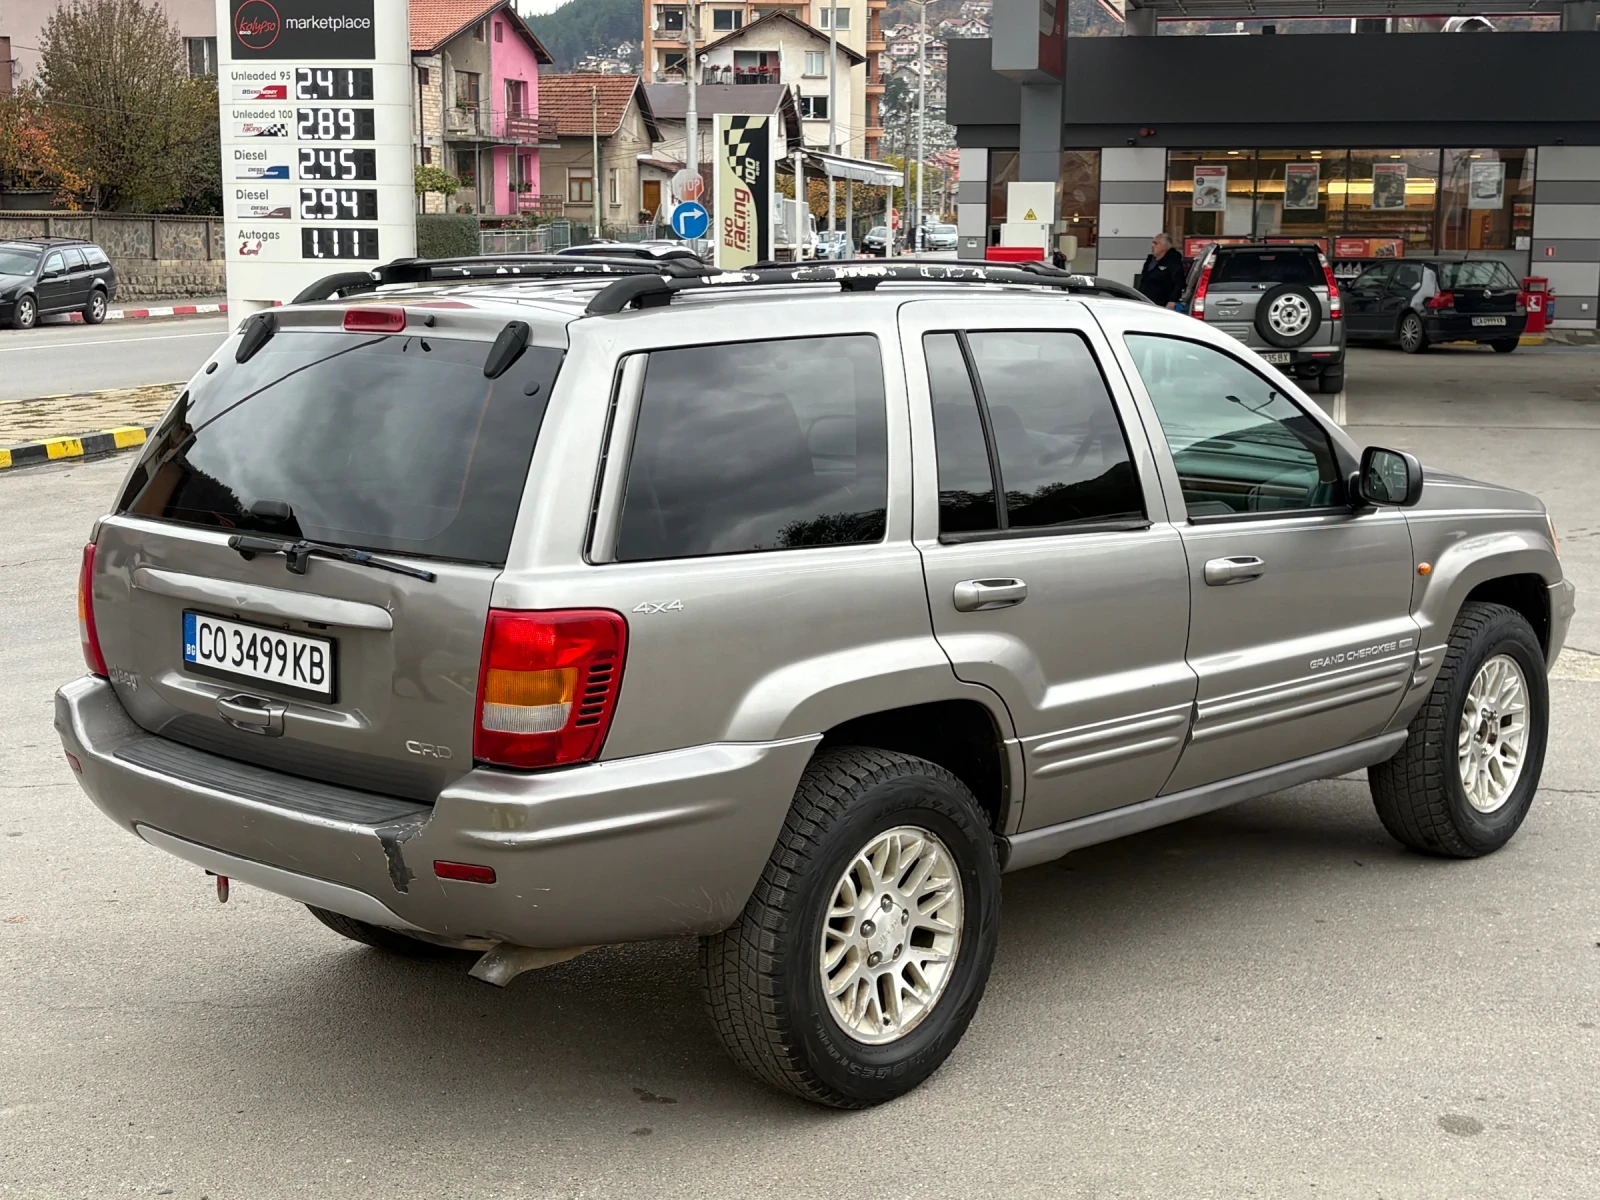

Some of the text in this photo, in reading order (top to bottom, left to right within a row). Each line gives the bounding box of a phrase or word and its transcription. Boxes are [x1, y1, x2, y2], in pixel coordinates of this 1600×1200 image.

[240, 15, 371, 35] kalypso marketplace
[231, 71, 291, 81] Unleaded 95
[296, 68, 354, 99] 2.41
[232, 109, 293, 119] Unleaded 100
[298, 108, 356, 140] 2.89
[234, 149, 267, 161] Diesel
[299, 148, 357, 179] 2.45
[745, 157, 756, 185] 100
[236, 189, 269, 200] Diesel
[301, 188, 358, 219] 2.94
[724, 216, 734, 247] EKO
[734, 188, 751, 252] racing
[238, 229, 280, 241] Autogas
[312, 229, 359, 258] 1.11
[186, 643, 196, 656] BG
[1309, 653, 1345, 669] GRAND
[1346, 641, 1397, 661] CHEROKEE
[405, 740, 454, 760] CRD
